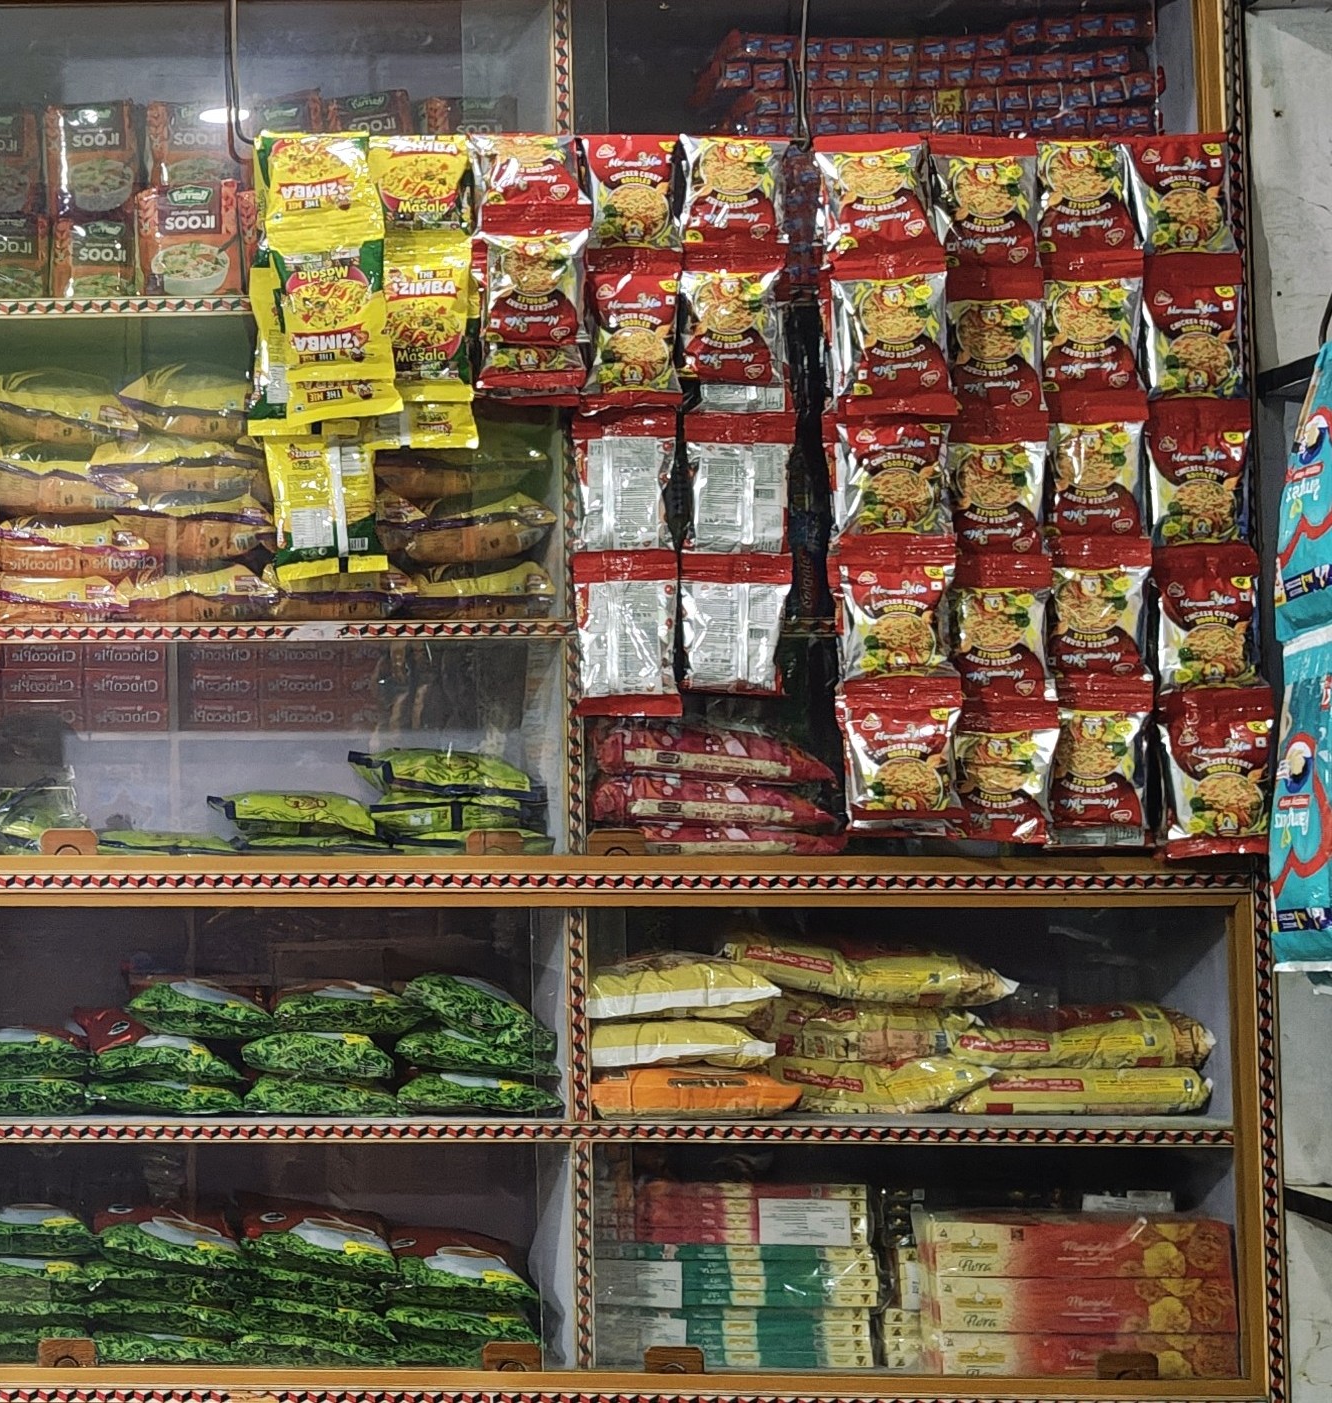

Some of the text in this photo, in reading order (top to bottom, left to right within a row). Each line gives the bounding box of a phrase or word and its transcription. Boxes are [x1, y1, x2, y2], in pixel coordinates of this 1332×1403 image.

[72, 132, 120, 148] SOOJI
[281, 182, 339, 201] ZIMBA
[398, 199, 449, 213] Masala
[164, 215, 216, 230] SOOJI
[79, 248, 127, 262] SOOJI
[297, 264, 350, 281] Masala
[418, 270, 434, 280] THE
[399, 279, 456, 295] ZIMBA
[295, 332, 354, 352] ZIMBA
[396, 348, 446, 363] Masala
[326, 388, 343, 400] THE
